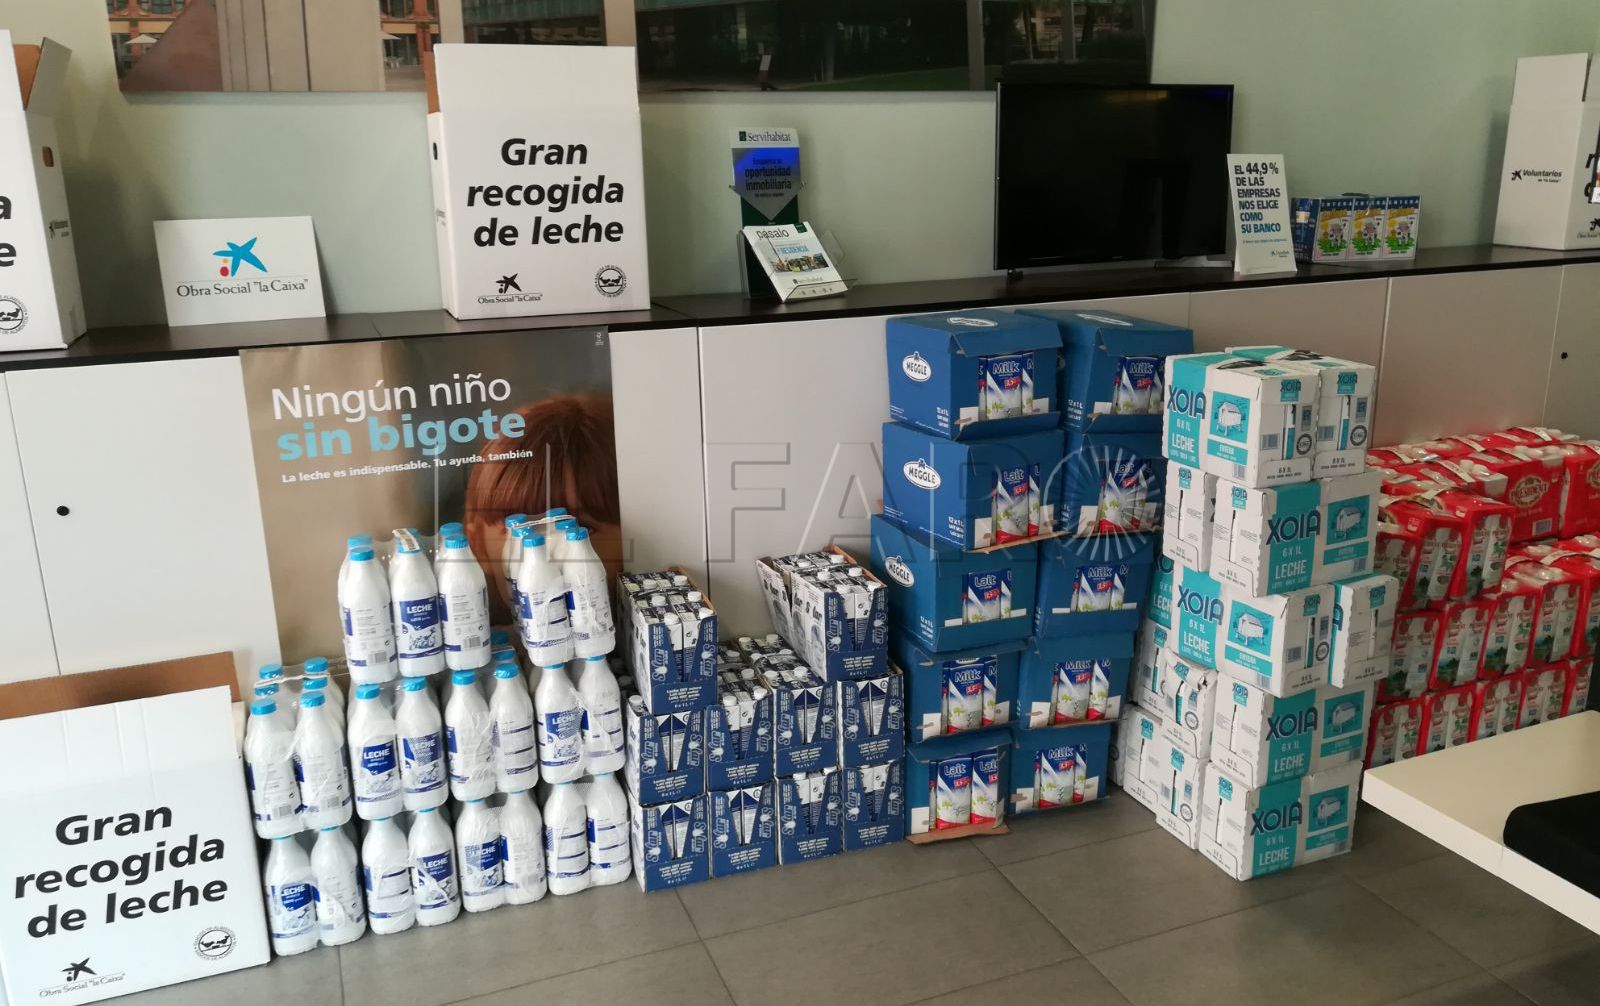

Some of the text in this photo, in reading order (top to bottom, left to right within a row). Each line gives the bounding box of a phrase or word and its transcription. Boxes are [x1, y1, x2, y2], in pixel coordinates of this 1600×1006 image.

[748, 132, 791, 142] Servihabitat
[501, 138, 588, 166] Gran
[745, 166, 792, 179] oportunidad
[1234, 161, 1279, 176] EL 44,9 %
[1522, 168, 1562, 178] Voluntarios
[745, 178, 792, 191] inmobiliaria
[1236, 176, 1265, 186] DE LAS
[467, 175, 624, 213] recogida
[1237, 188, 1280, 198] EMPRESAS
[1239, 199, 1279, 210] NOS ELIGE
[1240, 212, 1263, 222] COMO
[474, 214, 624, 247] de leche
[1241, 222, 1281, 234] SU BANCO
[176, 284, 211, 297] Obra
[213, 282, 251, 295] Social
[270, 278, 309, 292] Caixa"
[906, 361, 928, 376] MEGGLE
[993, 360, 1020, 374] Milk
[271, 373, 511, 423] Ningún niño
[1166, 385, 1207, 420] XOIA
[276, 408, 526, 461] sin bigote
[1171, 432, 1195, 454] LECHE
[281, 449, 533, 483] La leche es indispensable. Tu ayuda, también
[908, 466, 936, 485] MEGGLE
[1003, 468, 1025, 483] Lait
[1265, 508, 1321, 546] XOIA
[888, 562, 910, 583] MEGGLE
[1088, 566, 1113, 578] Milk
[1275, 559, 1307, 580] LECHE
[974, 574, 997, 587] Lait
[406, 603, 433, 614] LECHE
[1177, 584, 1225, 626] XOIA
[1183, 630, 1210, 655] LECHE
[954, 669, 982, 683] Milk
[1265, 706, 1318, 742] XOIA
[363, 749, 390, 760] LECHE
[1274, 753, 1305, 774] LECHE
[943, 763, 967, 776] Lait
[55, 806, 173, 846] Gran
[1250, 801, 1303, 836] XOIA
[423, 857, 448, 870] LECHE
[1259, 847, 1290, 866] LECHE
[15, 834, 225, 899] recogida
[27, 879, 228, 938] de leche
